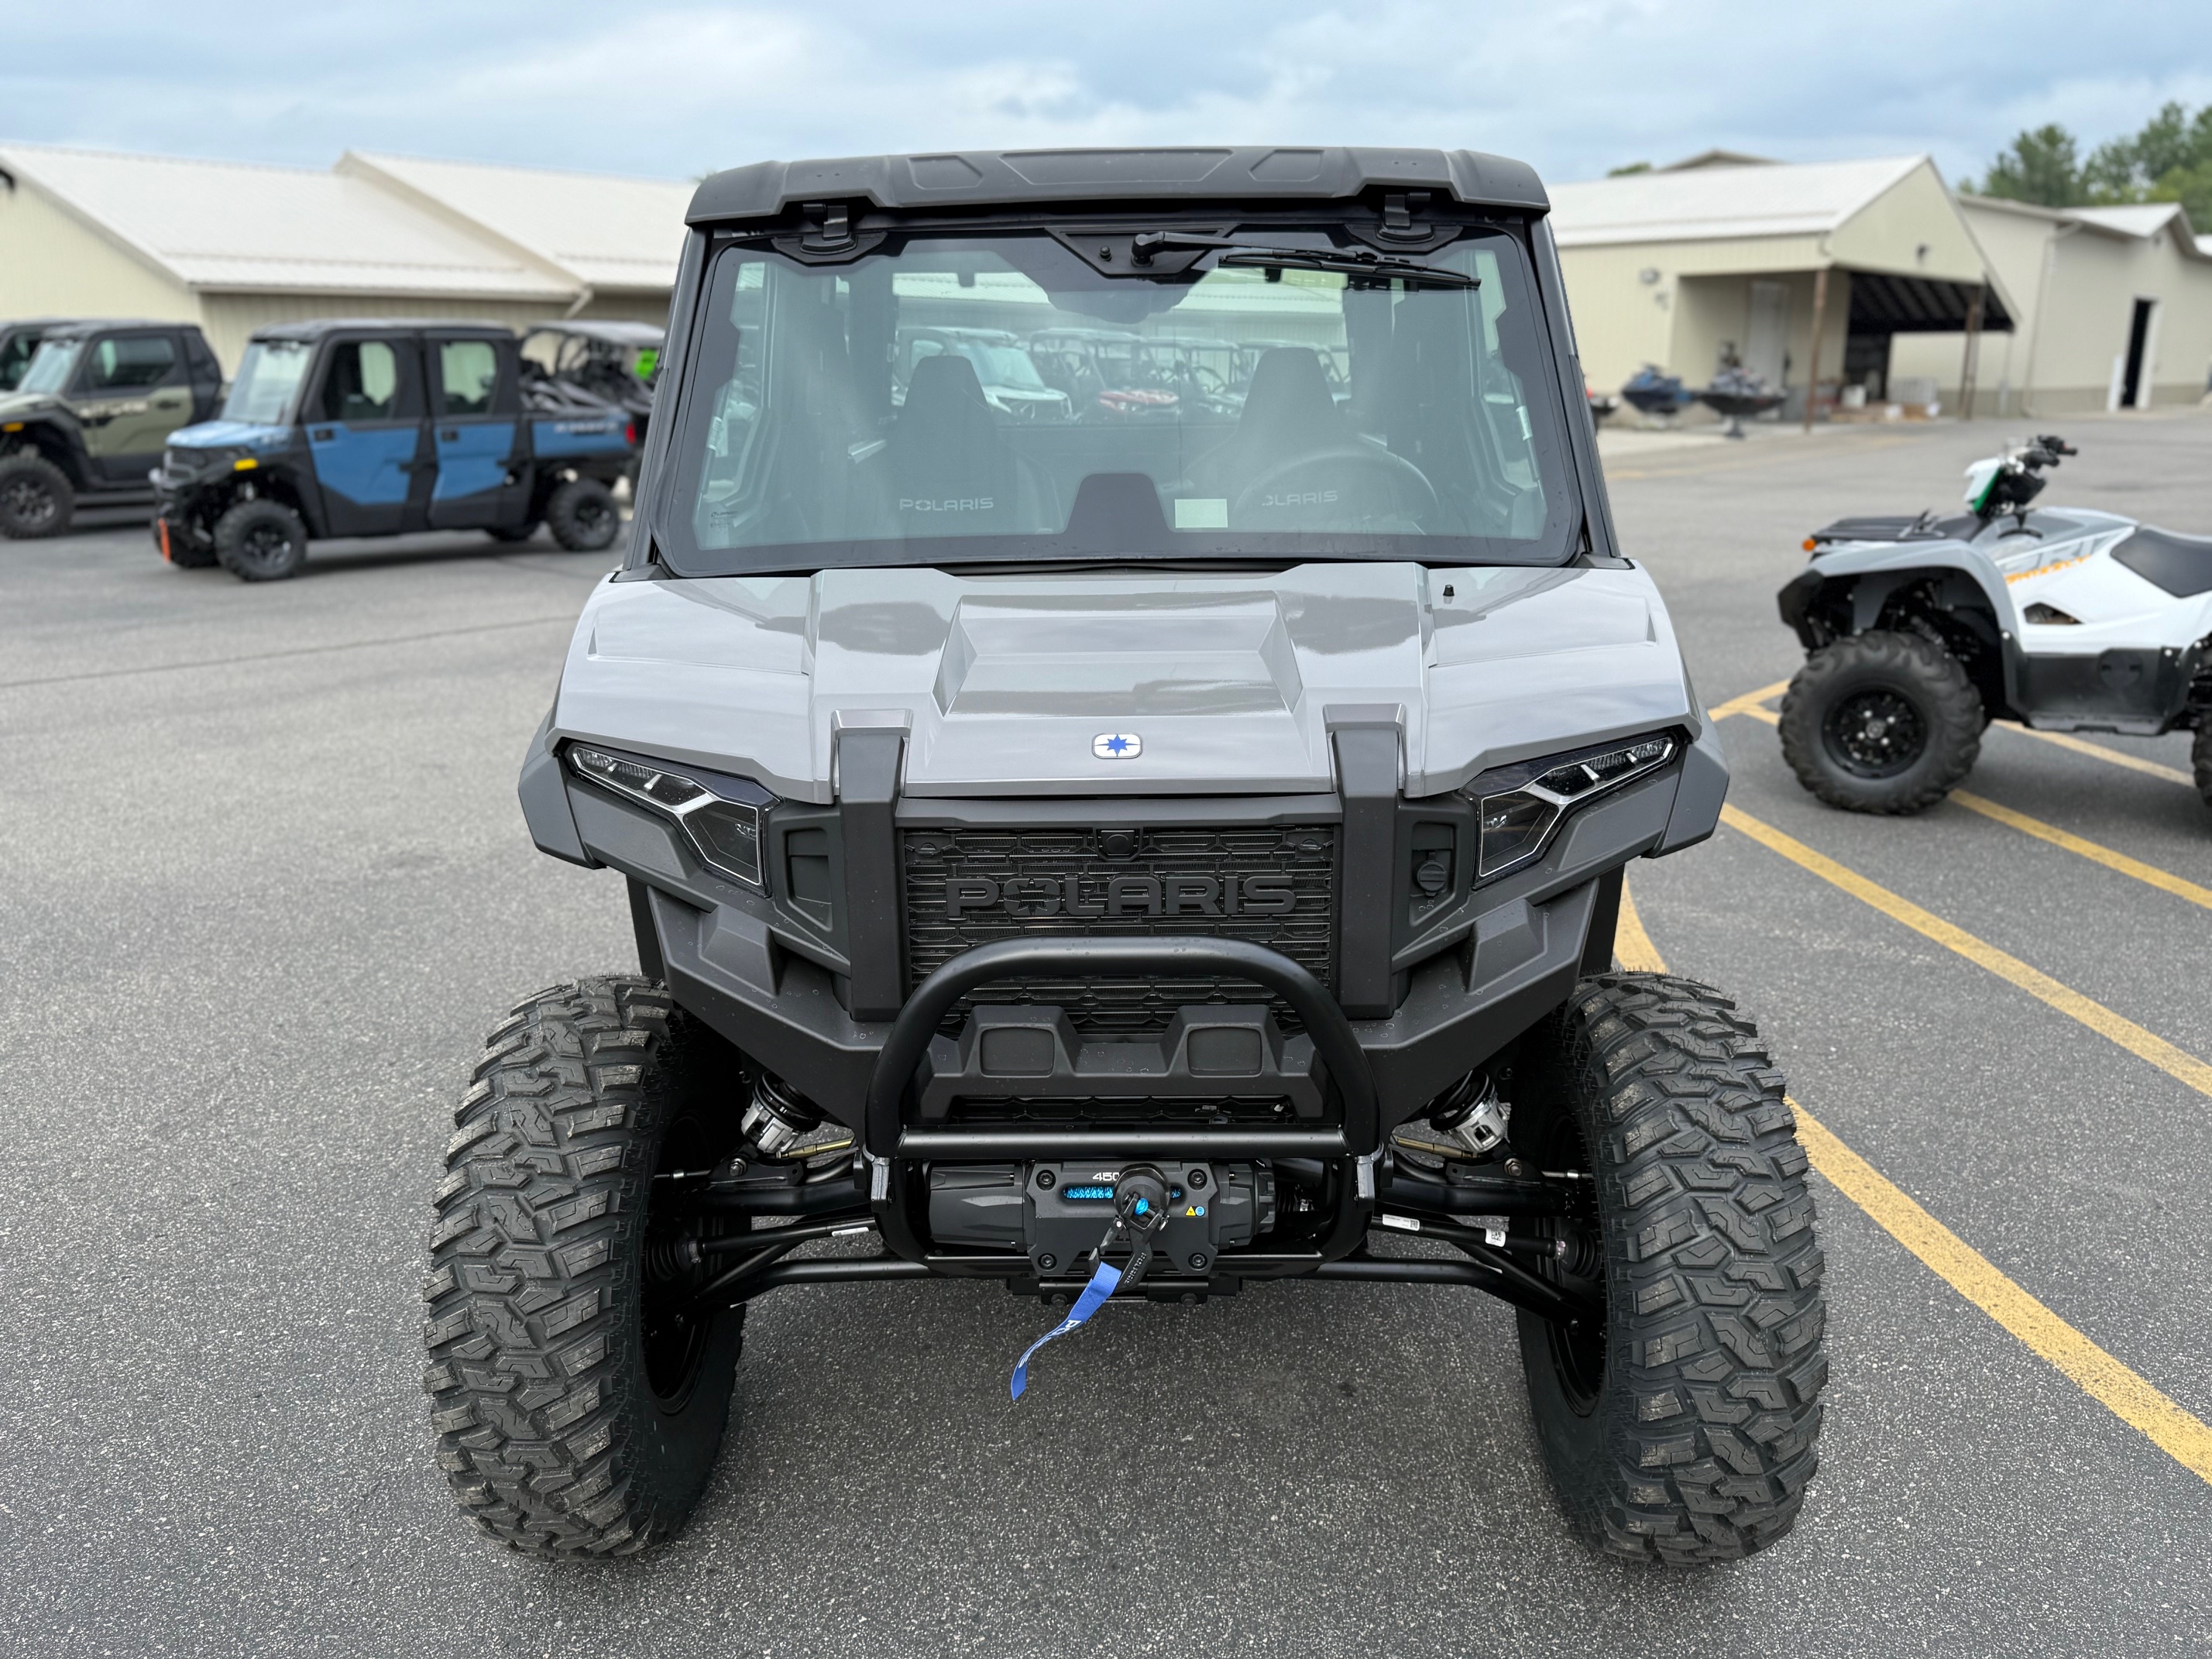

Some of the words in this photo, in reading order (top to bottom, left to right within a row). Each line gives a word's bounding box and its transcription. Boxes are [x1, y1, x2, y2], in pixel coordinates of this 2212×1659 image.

[899, 497, 994, 511] POLARIS
[1261, 489, 1338, 507] OLARIS
[945, 875, 1297, 917] POLARIS
